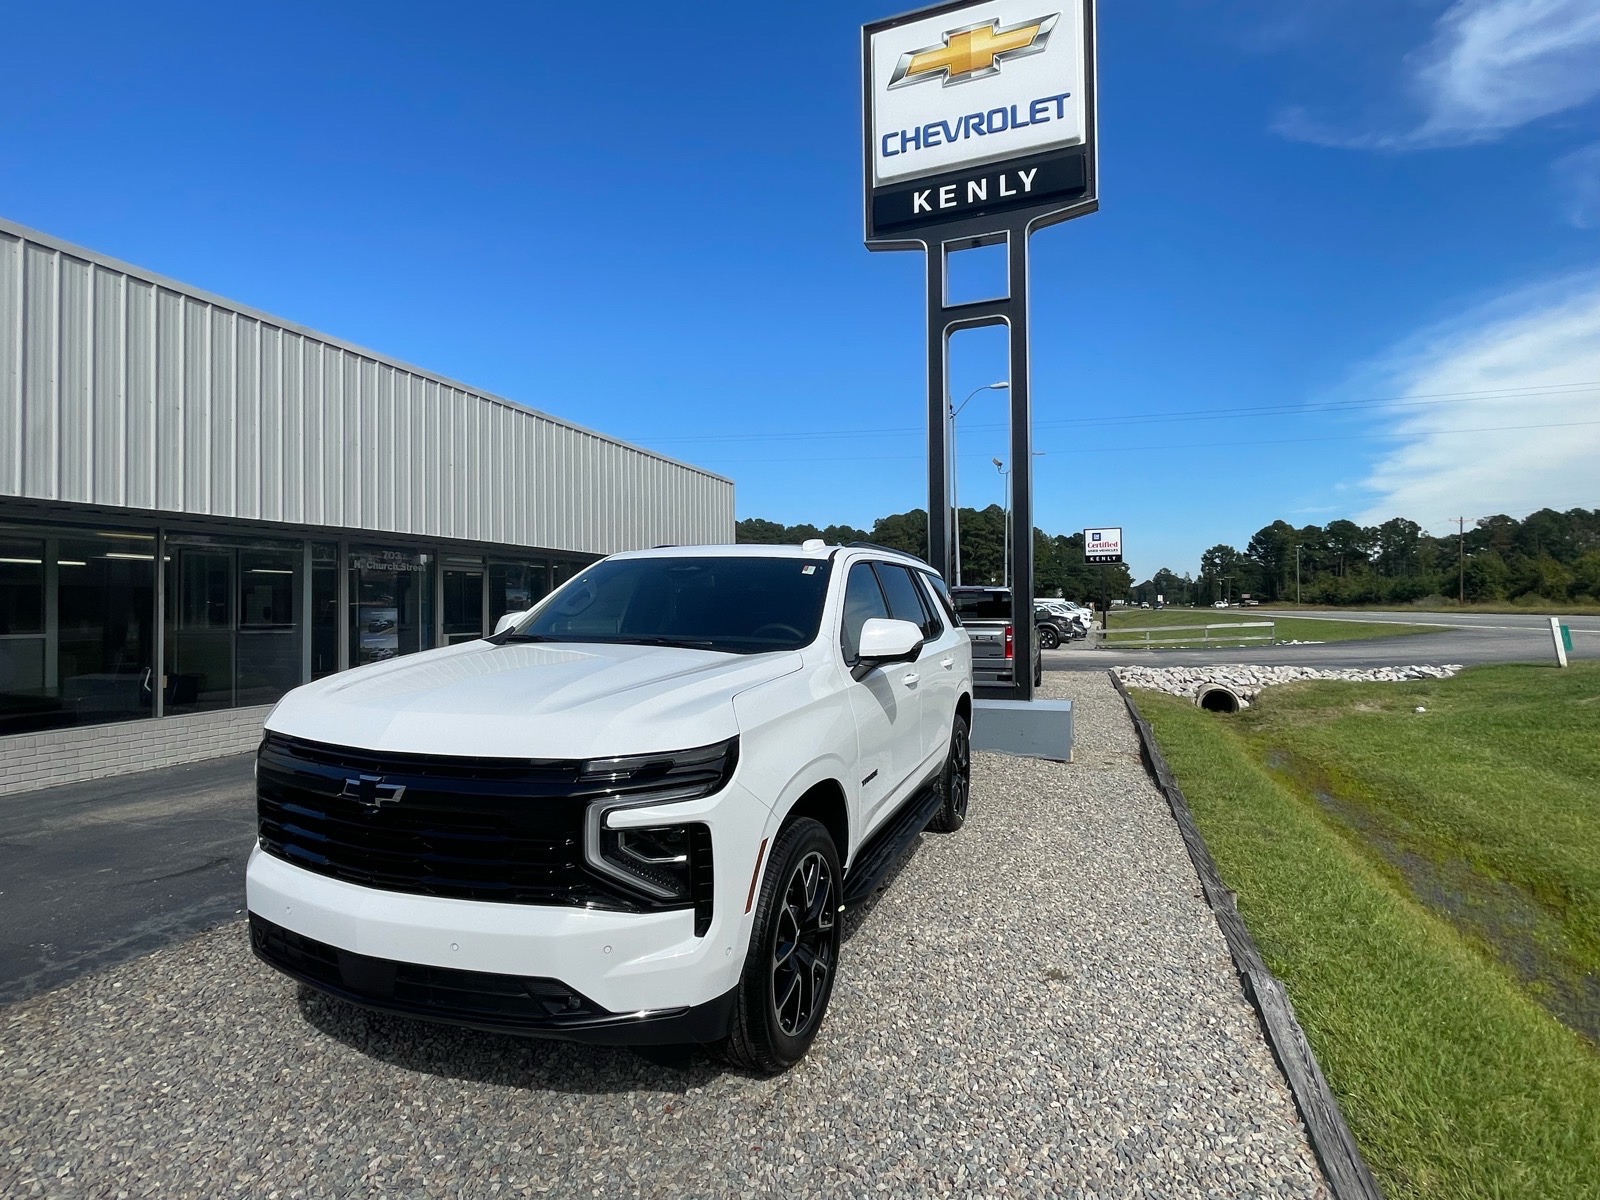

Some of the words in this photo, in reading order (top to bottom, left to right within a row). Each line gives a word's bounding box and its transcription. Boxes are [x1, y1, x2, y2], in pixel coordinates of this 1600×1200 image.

[882, 92, 1071, 157] CHEVROLET
[913, 168, 1038, 214] KENLY
[1087, 541, 1118, 549] Certified
[382, 551, 400, 560] 703
[366, 561, 399, 570] Church
[400, 562, 426, 572] Street
